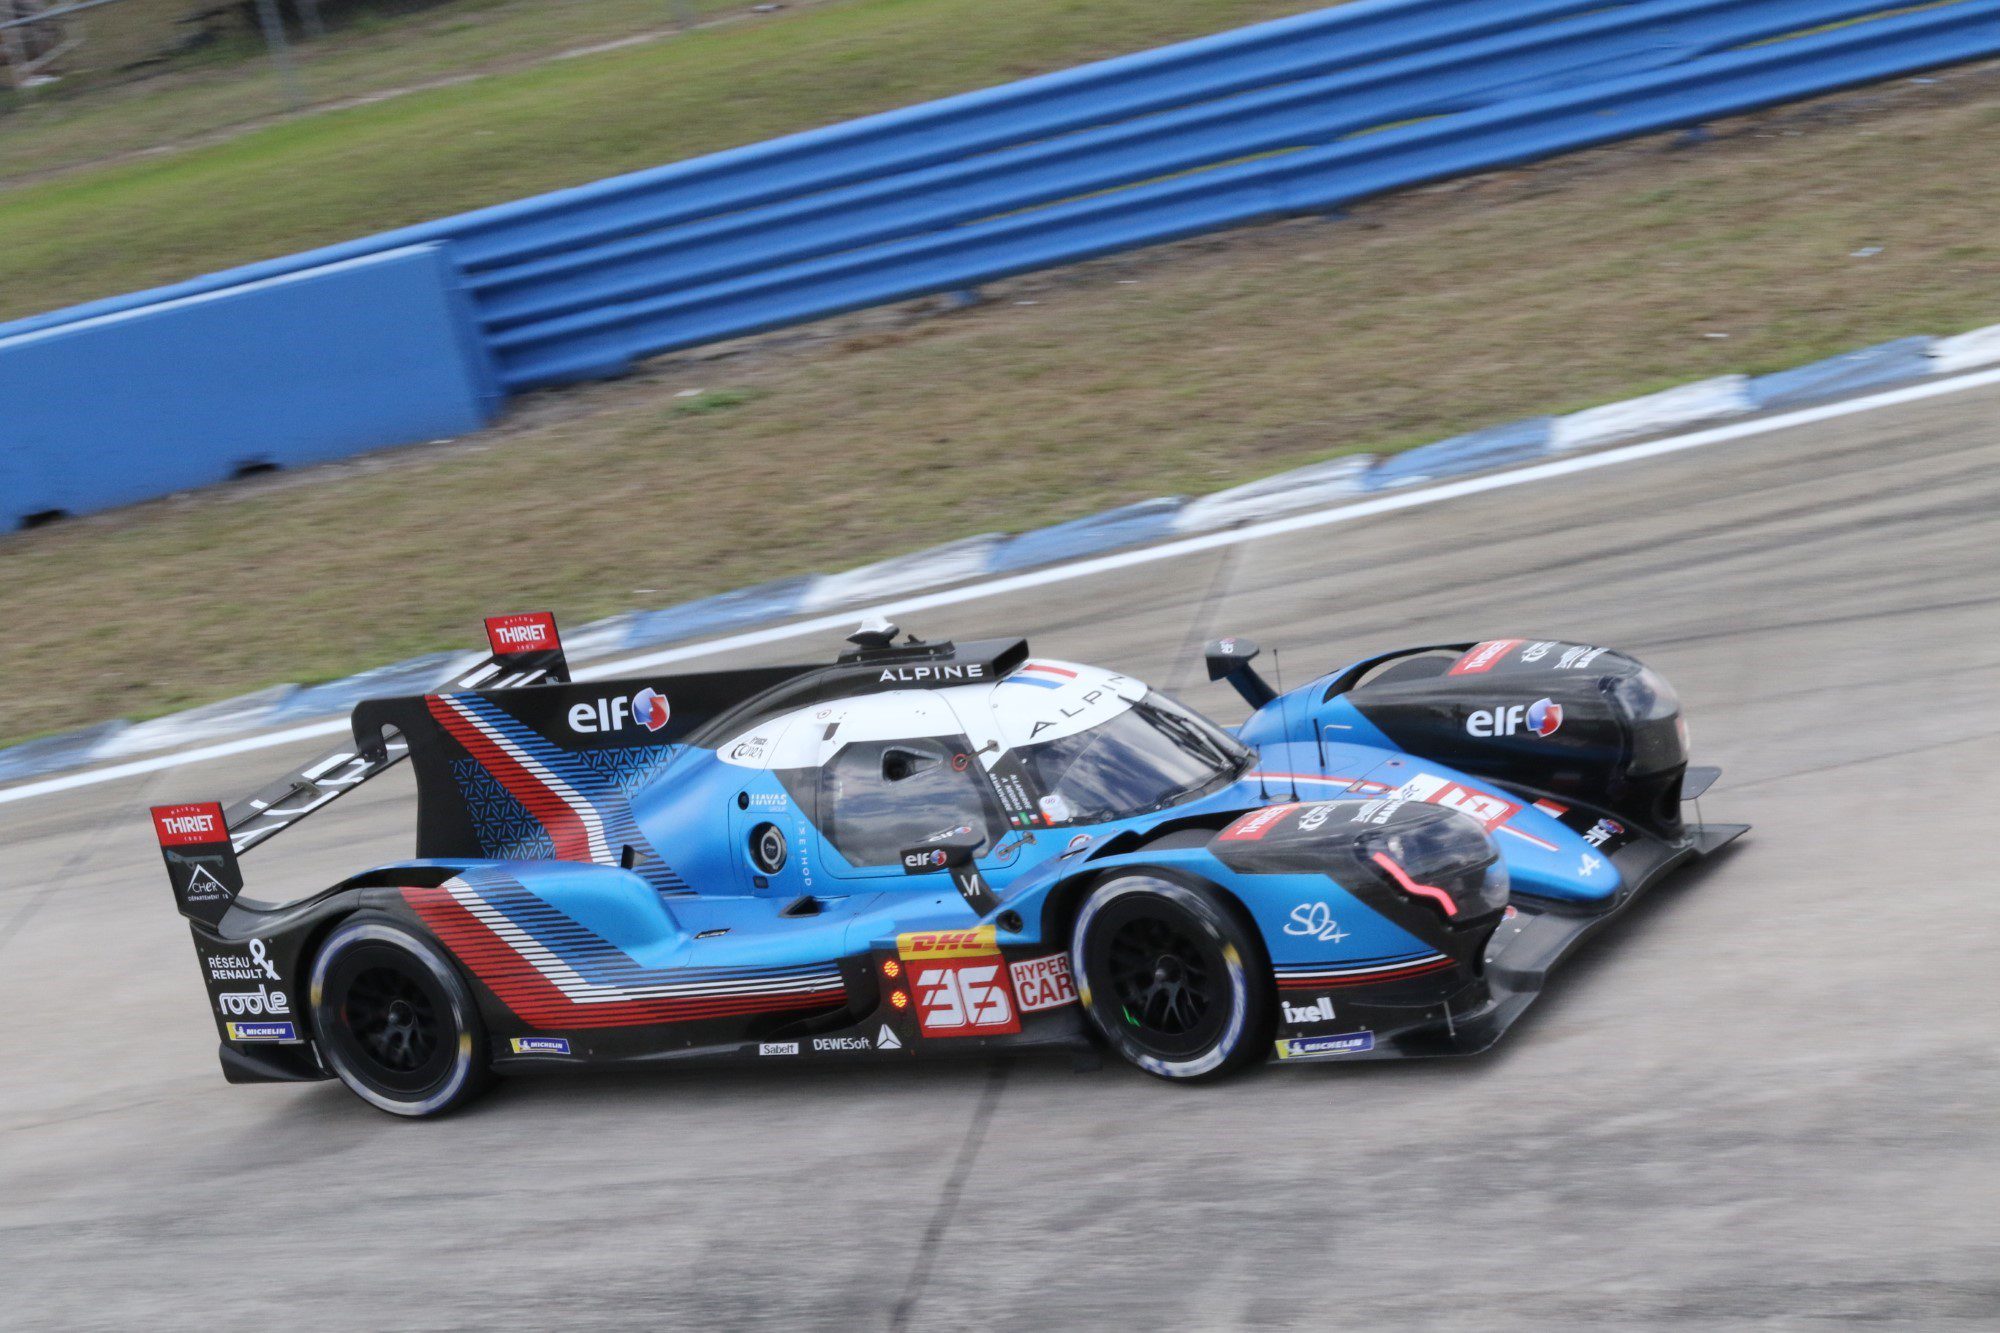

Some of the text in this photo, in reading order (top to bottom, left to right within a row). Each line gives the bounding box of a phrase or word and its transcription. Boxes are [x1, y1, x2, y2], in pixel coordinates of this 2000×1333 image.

[495, 624, 546, 643] THIRIET
[879, 664, 984, 682] ALPINE
[567, 695, 629, 733] elf
[1465, 704, 1525, 738] elf
[750, 793, 788, 806] HAVAS
[161, 814, 214, 835] THIRIET
[904, 852, 931, 867] elf
[910, 932, 983, 952] DHL
[208, 955, 250, 969] RÉSEAU
[1013, 955, 1069, 982] HYPER
[211, 968, 263, 980] RENAULT
[916, 965, 1013, 1029] 36
[1019, 972, 1077, 1008] CAR
[1281, 997, 1336, 1024] ixell
[246, 1028, 286, 1036] MICHELIN
[530, 1041, 563, 1049] MICHELIN
[812, 1037, 870, 1051] DEWESoft
[1303, 1037, 1364, 1051] MICHELIN
